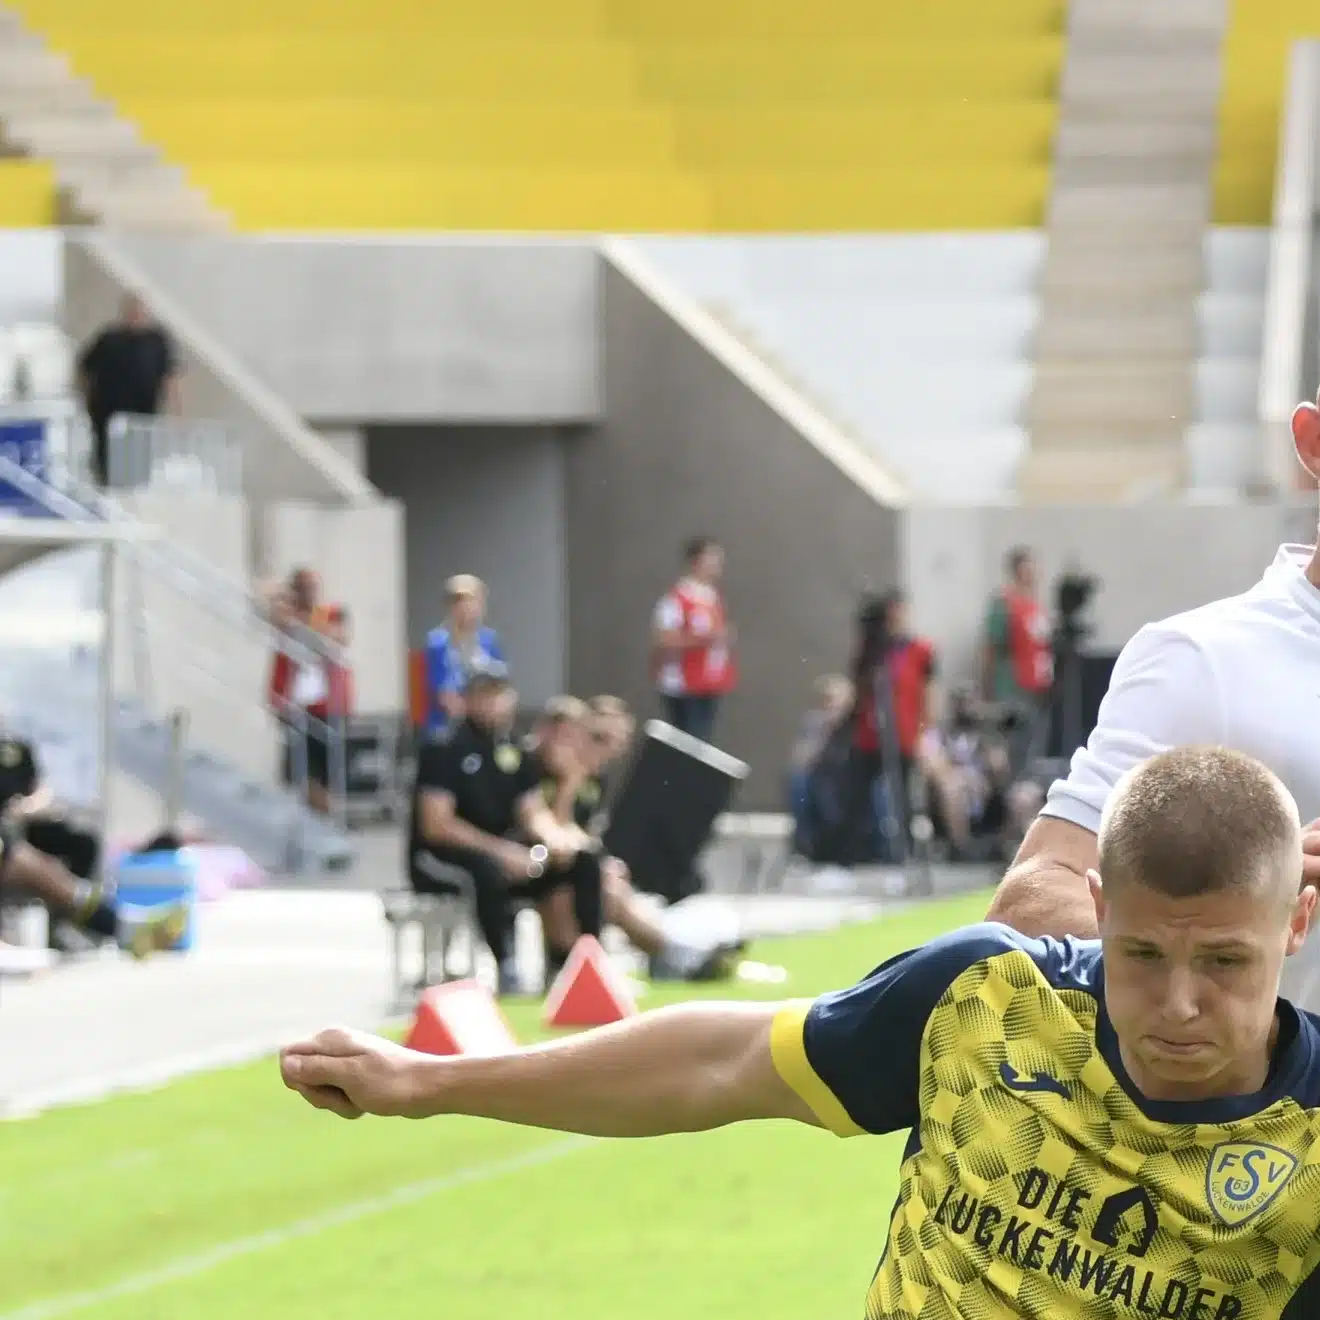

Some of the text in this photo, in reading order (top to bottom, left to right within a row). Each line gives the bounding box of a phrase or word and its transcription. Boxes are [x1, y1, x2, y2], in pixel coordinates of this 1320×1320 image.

[1017, 1166, 1092, 1231] DIE
[1217, 1149, 1288, 1201] FSV
[1233, 1180, 1250, 1192] 63
